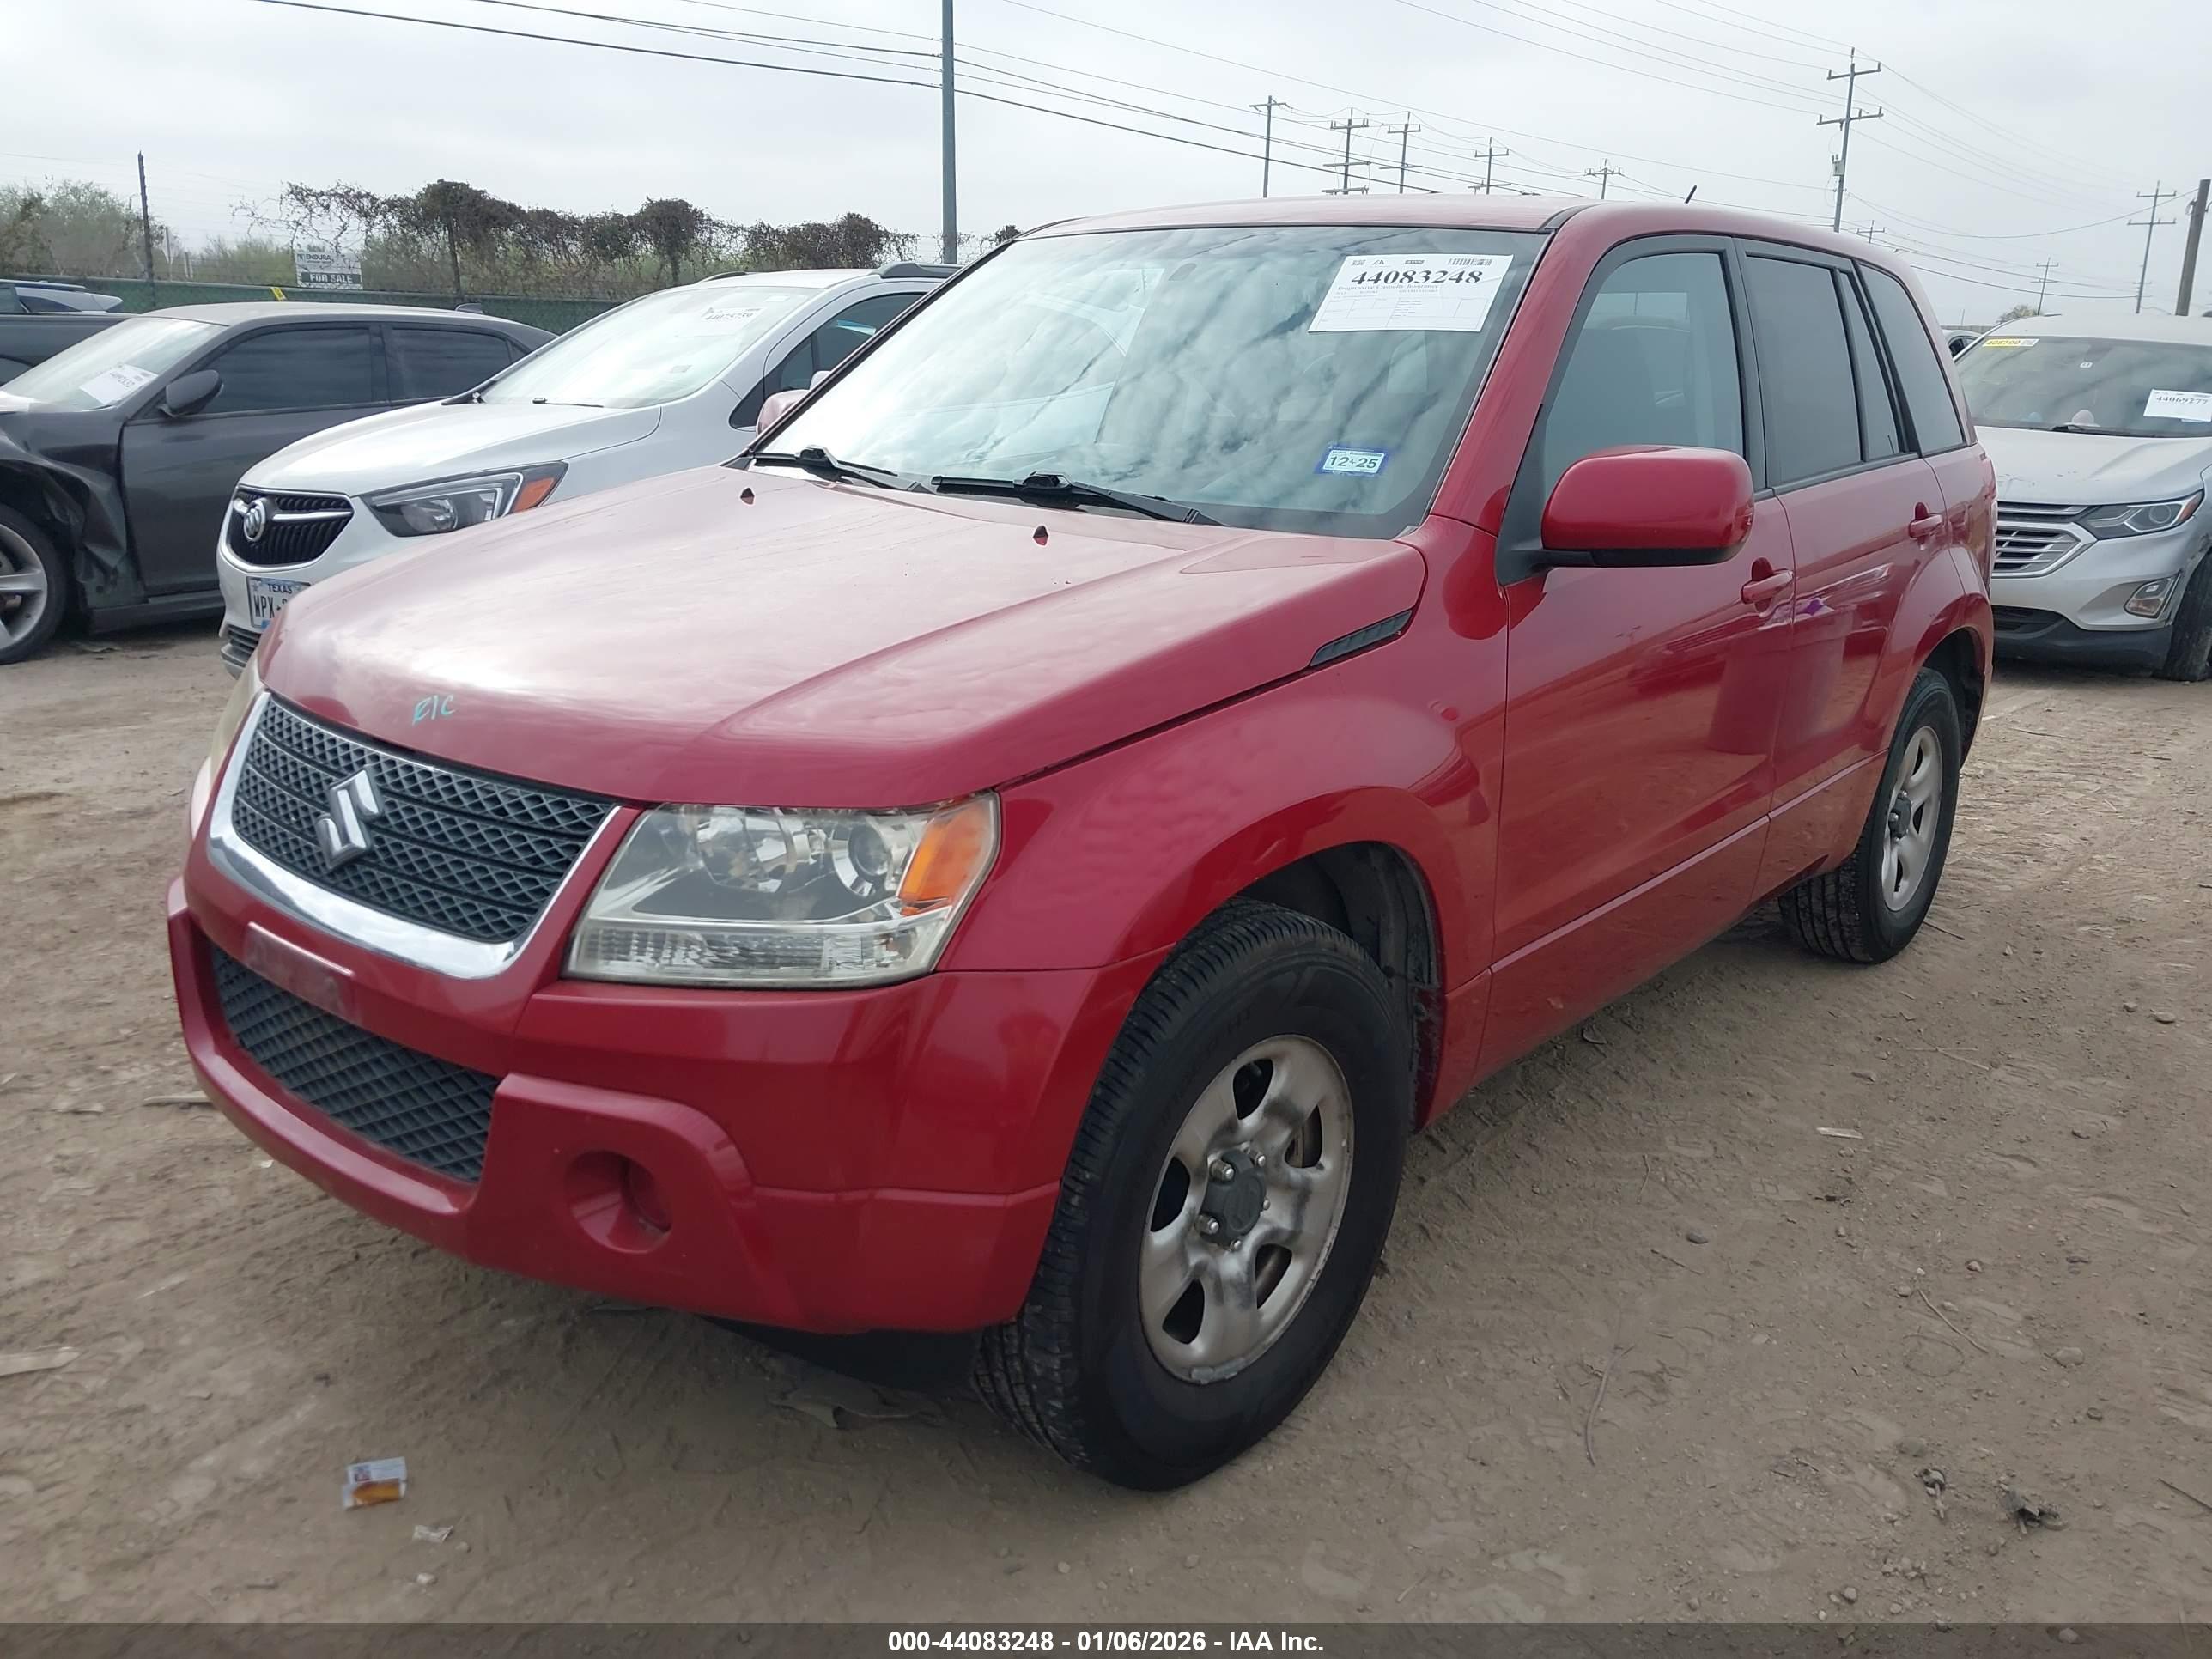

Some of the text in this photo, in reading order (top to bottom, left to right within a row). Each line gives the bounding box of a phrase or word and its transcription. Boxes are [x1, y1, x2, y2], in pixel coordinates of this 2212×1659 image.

[309, 273, 353, 283] FOR SALE
[1352, 270, 1484, 285] 44083248
[267, 584, 293, 594] TEXAS
